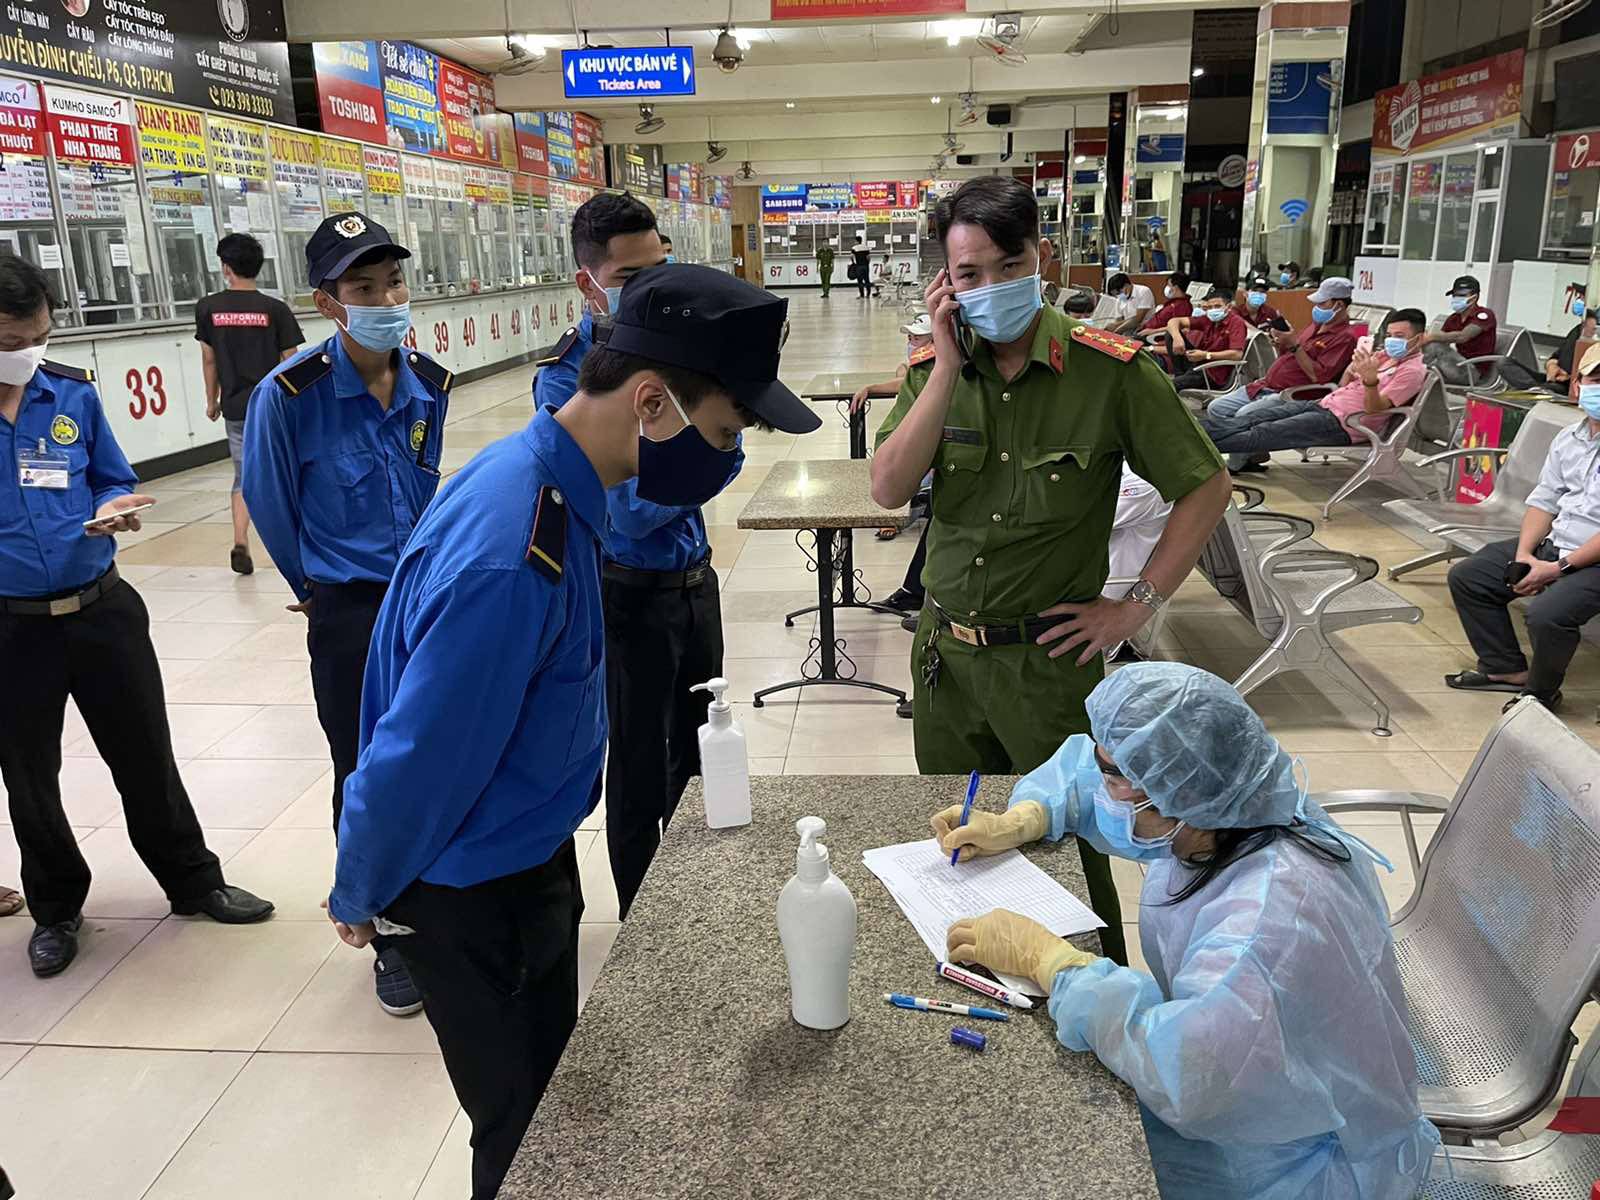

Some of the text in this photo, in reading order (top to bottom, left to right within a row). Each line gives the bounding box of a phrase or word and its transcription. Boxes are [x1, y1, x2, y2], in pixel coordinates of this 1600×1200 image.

[106, 15, 120, 30] CẤY
[120, 18, 135, 34] TÓC
[151, 10, 165, 28] SẸO
[108, 32, 122, 48] CẤY
[36, 38, 69, 72] ĐÌNH
[140, 66, 175, 95] TP.HCM
[580, 58, 606, 73] KHU
[608, 57, 633, 76] VỰC
[634, 54, 662, 72] BÁN
[598, 78, 662, 91] Tickets Area
[52, 98, 116, 118] KUMHO SAMCO
[328, 96, 378, 125] TOSHIBA
[18, 113, 36, 132] LẠT
[60, 120, 118, 142] PHAN THIẾT
[64, 140, 121, 160] NHA TRANG
[154, 148, 178, 166] TRANG
[765, 199, 803, 208] SAMSUNG
[770, 266, 782, 278] 67
[796, 266, 809, 276] 68
[898, 262, 911, 274] 72
[511, 309, 520, 336] 42
[531, 304, 540, 330] 43
[550, 303, 558, 327] 44
[566, 301, 574, 323] 45
[463, 316, 476, 347] 40
[490, 312, 500, 340] 41
[434, 321, 449, 354] 39
[126, 366, 167, 420] 33
